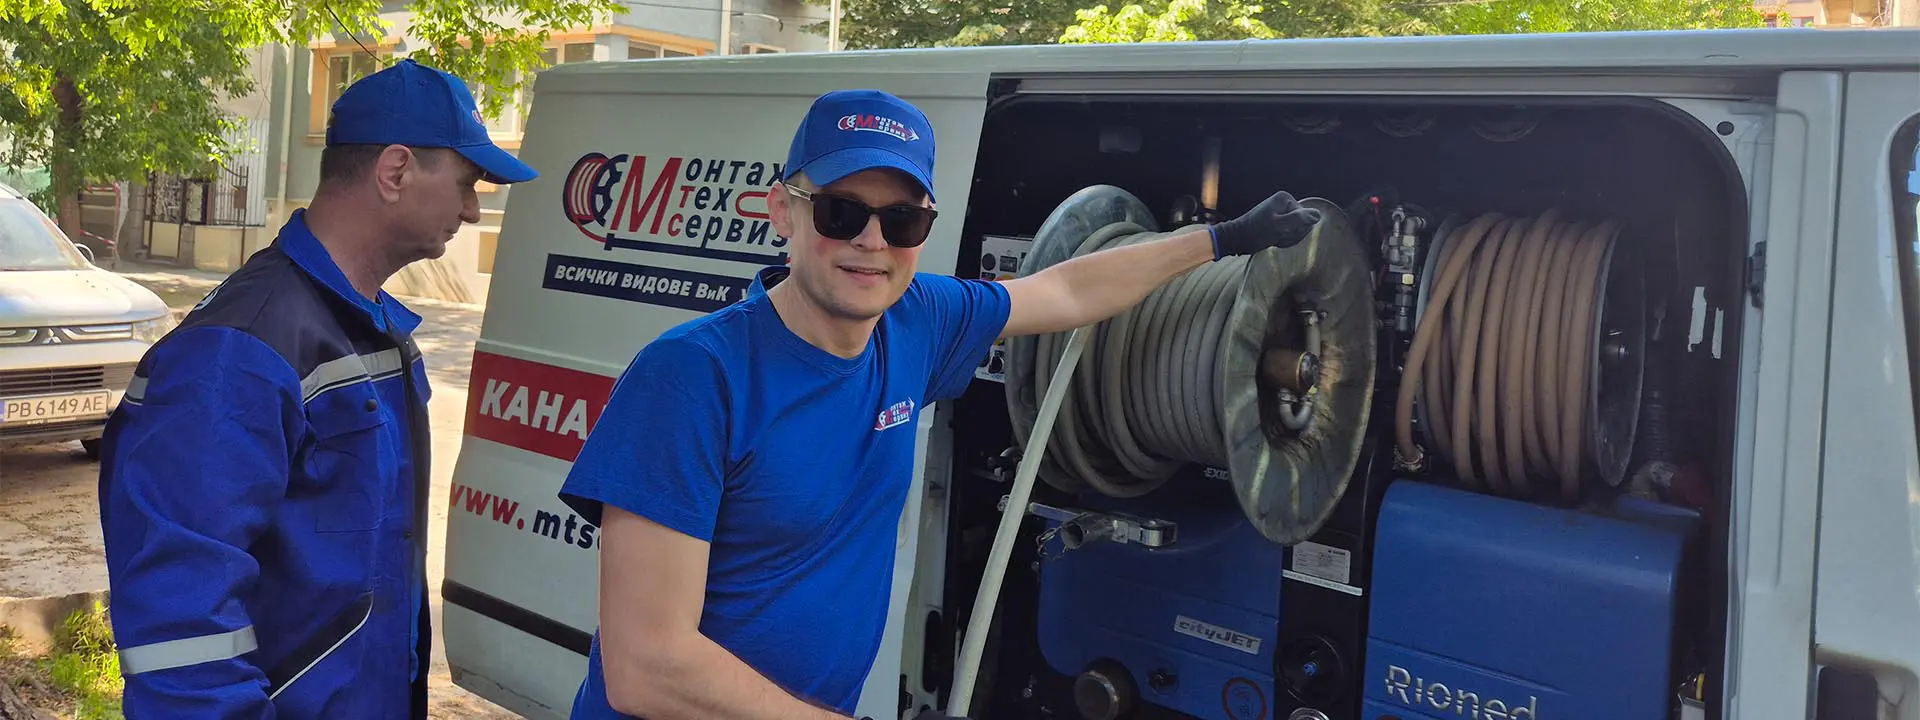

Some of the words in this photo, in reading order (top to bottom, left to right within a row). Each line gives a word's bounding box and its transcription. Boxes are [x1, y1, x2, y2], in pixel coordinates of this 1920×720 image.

[554, 265, 618, 286] ВСИЧКИ
[620, 273, 692, 296] ВИДОВЕ
[7, 402, 31, 419] PB
[35, 398, 79, 416] 6149
[82, 395, 104, 413] AE
[479, 378, 607, 440] КАНА
